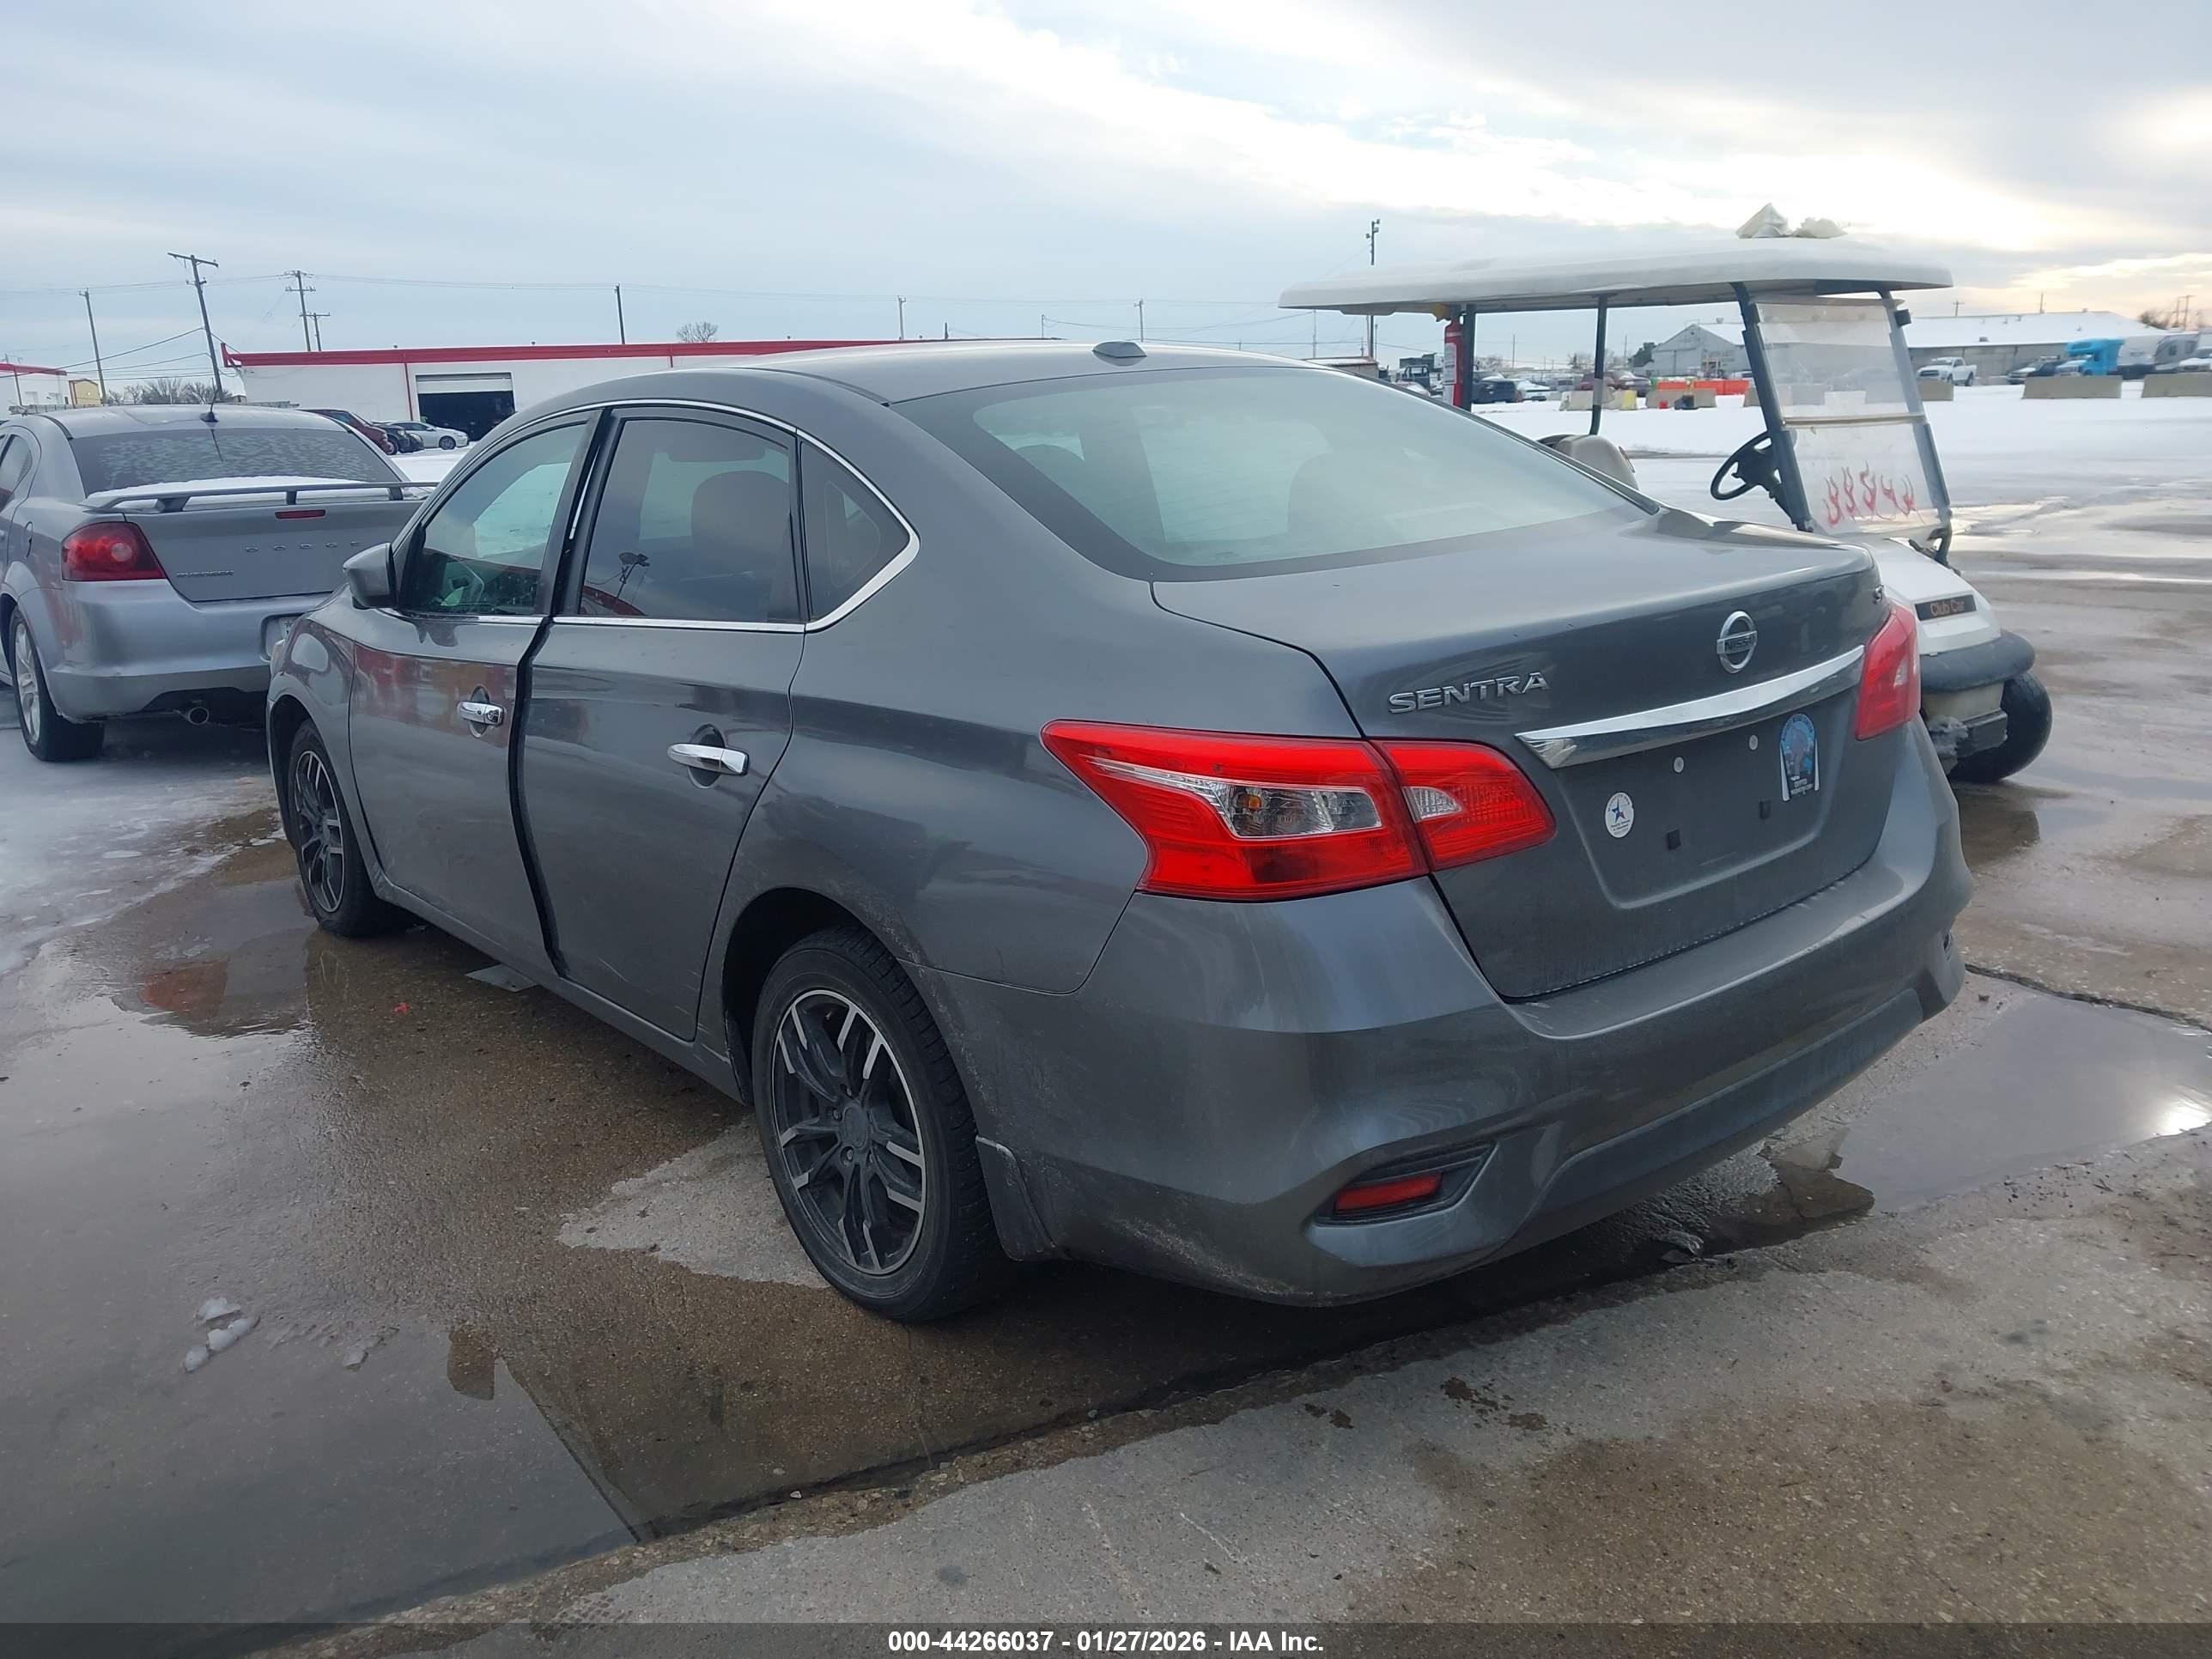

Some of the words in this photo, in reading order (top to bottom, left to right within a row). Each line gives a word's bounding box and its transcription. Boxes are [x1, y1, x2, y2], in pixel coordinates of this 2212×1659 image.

[1930, 600, 1950, 617] Club
[1950, 598, 1966, 613] Car
[1389, 672, 1550, 714] SENTRA
